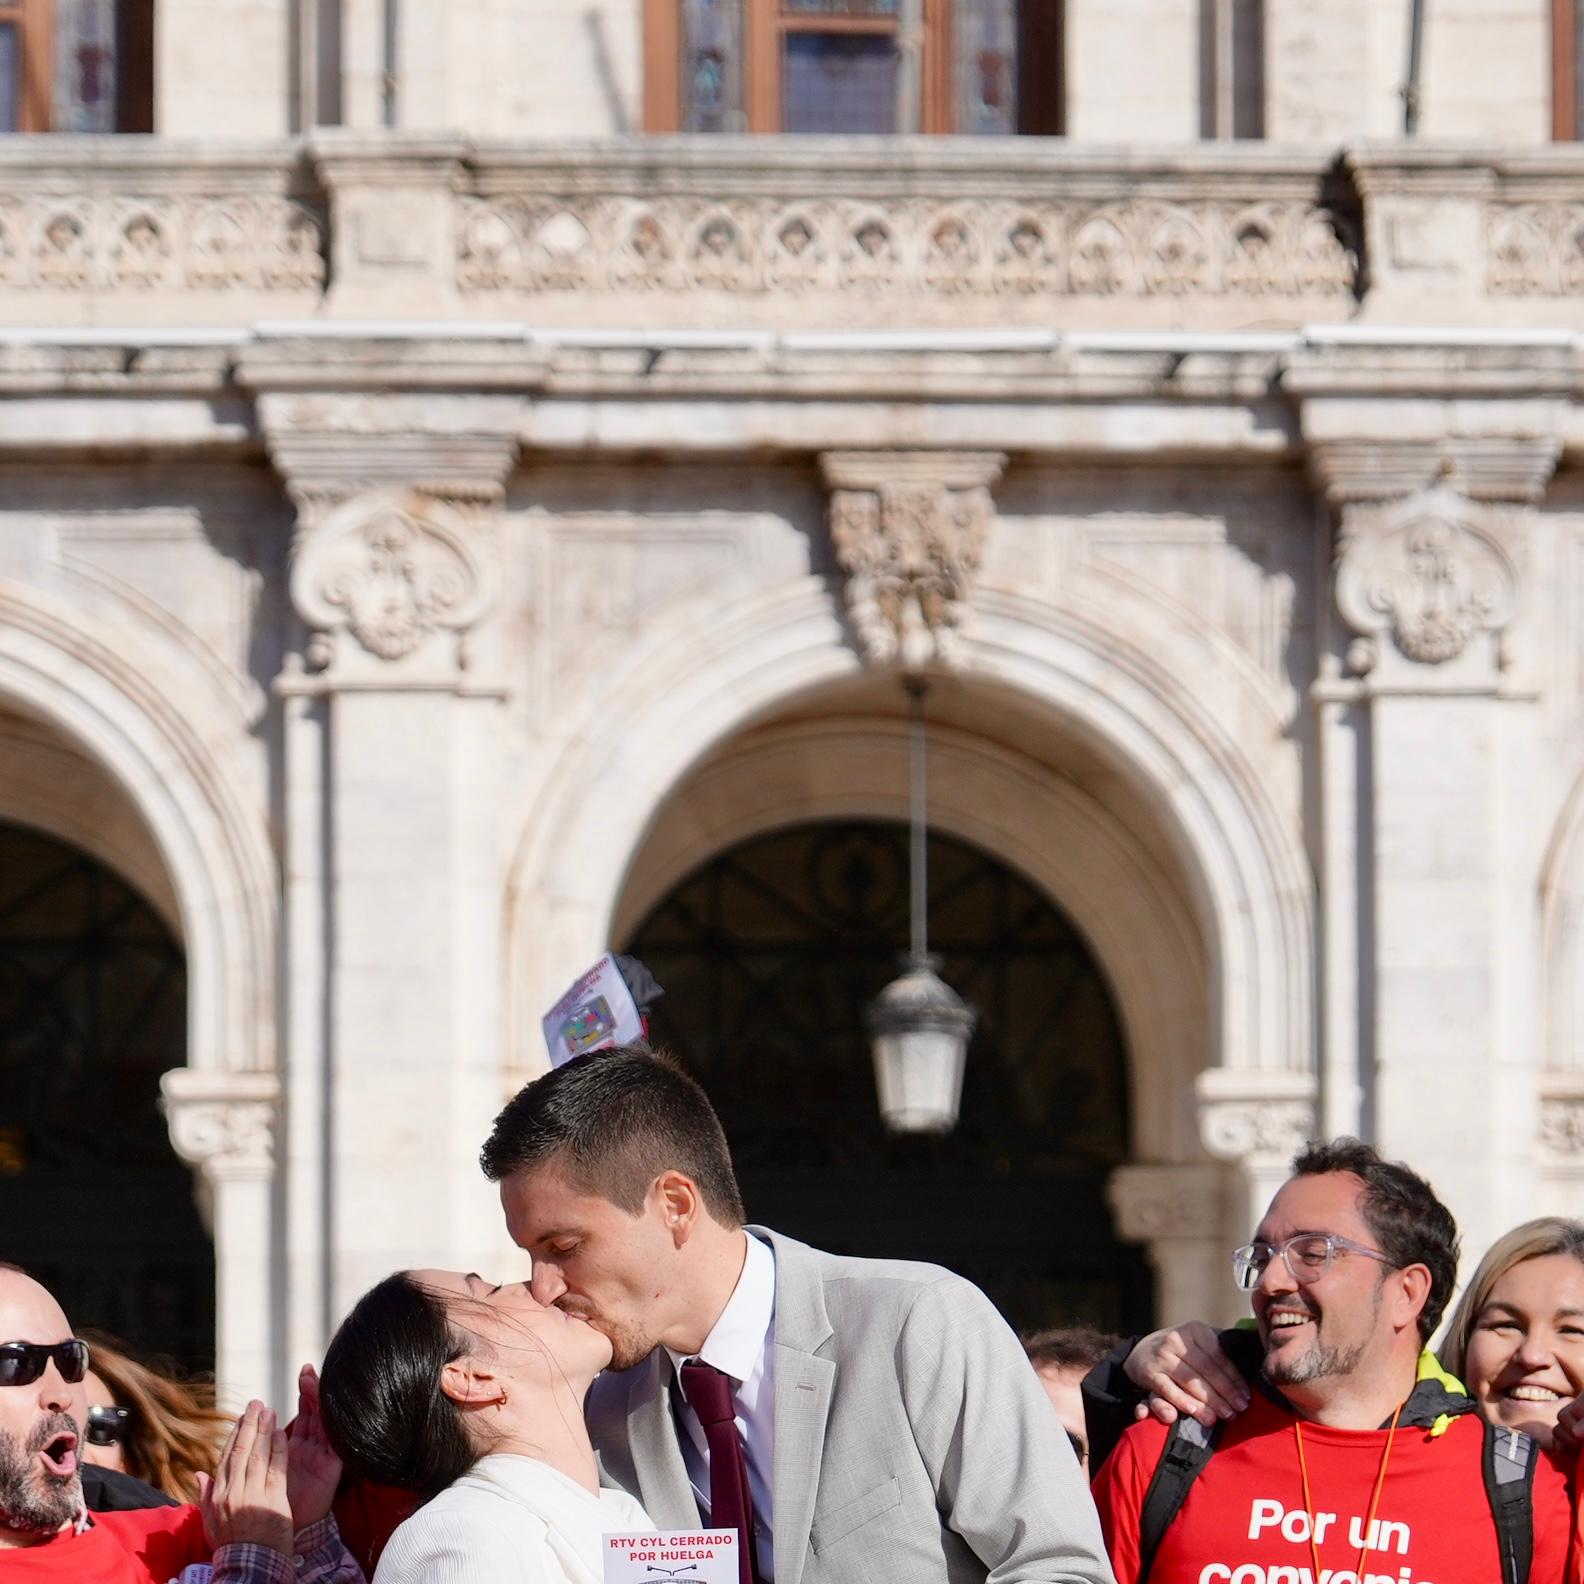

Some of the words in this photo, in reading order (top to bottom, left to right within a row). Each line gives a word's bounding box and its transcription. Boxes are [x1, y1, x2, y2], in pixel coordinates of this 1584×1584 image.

[1247, 1498, 1336, 1545] Por
[1348, 1515, 1411, 1555] un
[610, 1539, 635, 1548] RTV
[640, 1537, 666, 1547] CYL
[670, 1535, 732, 1546] CERRADO
[630, 1552, 656, 1561] POR
[661, 1550, 714, 1560] HUELGA
